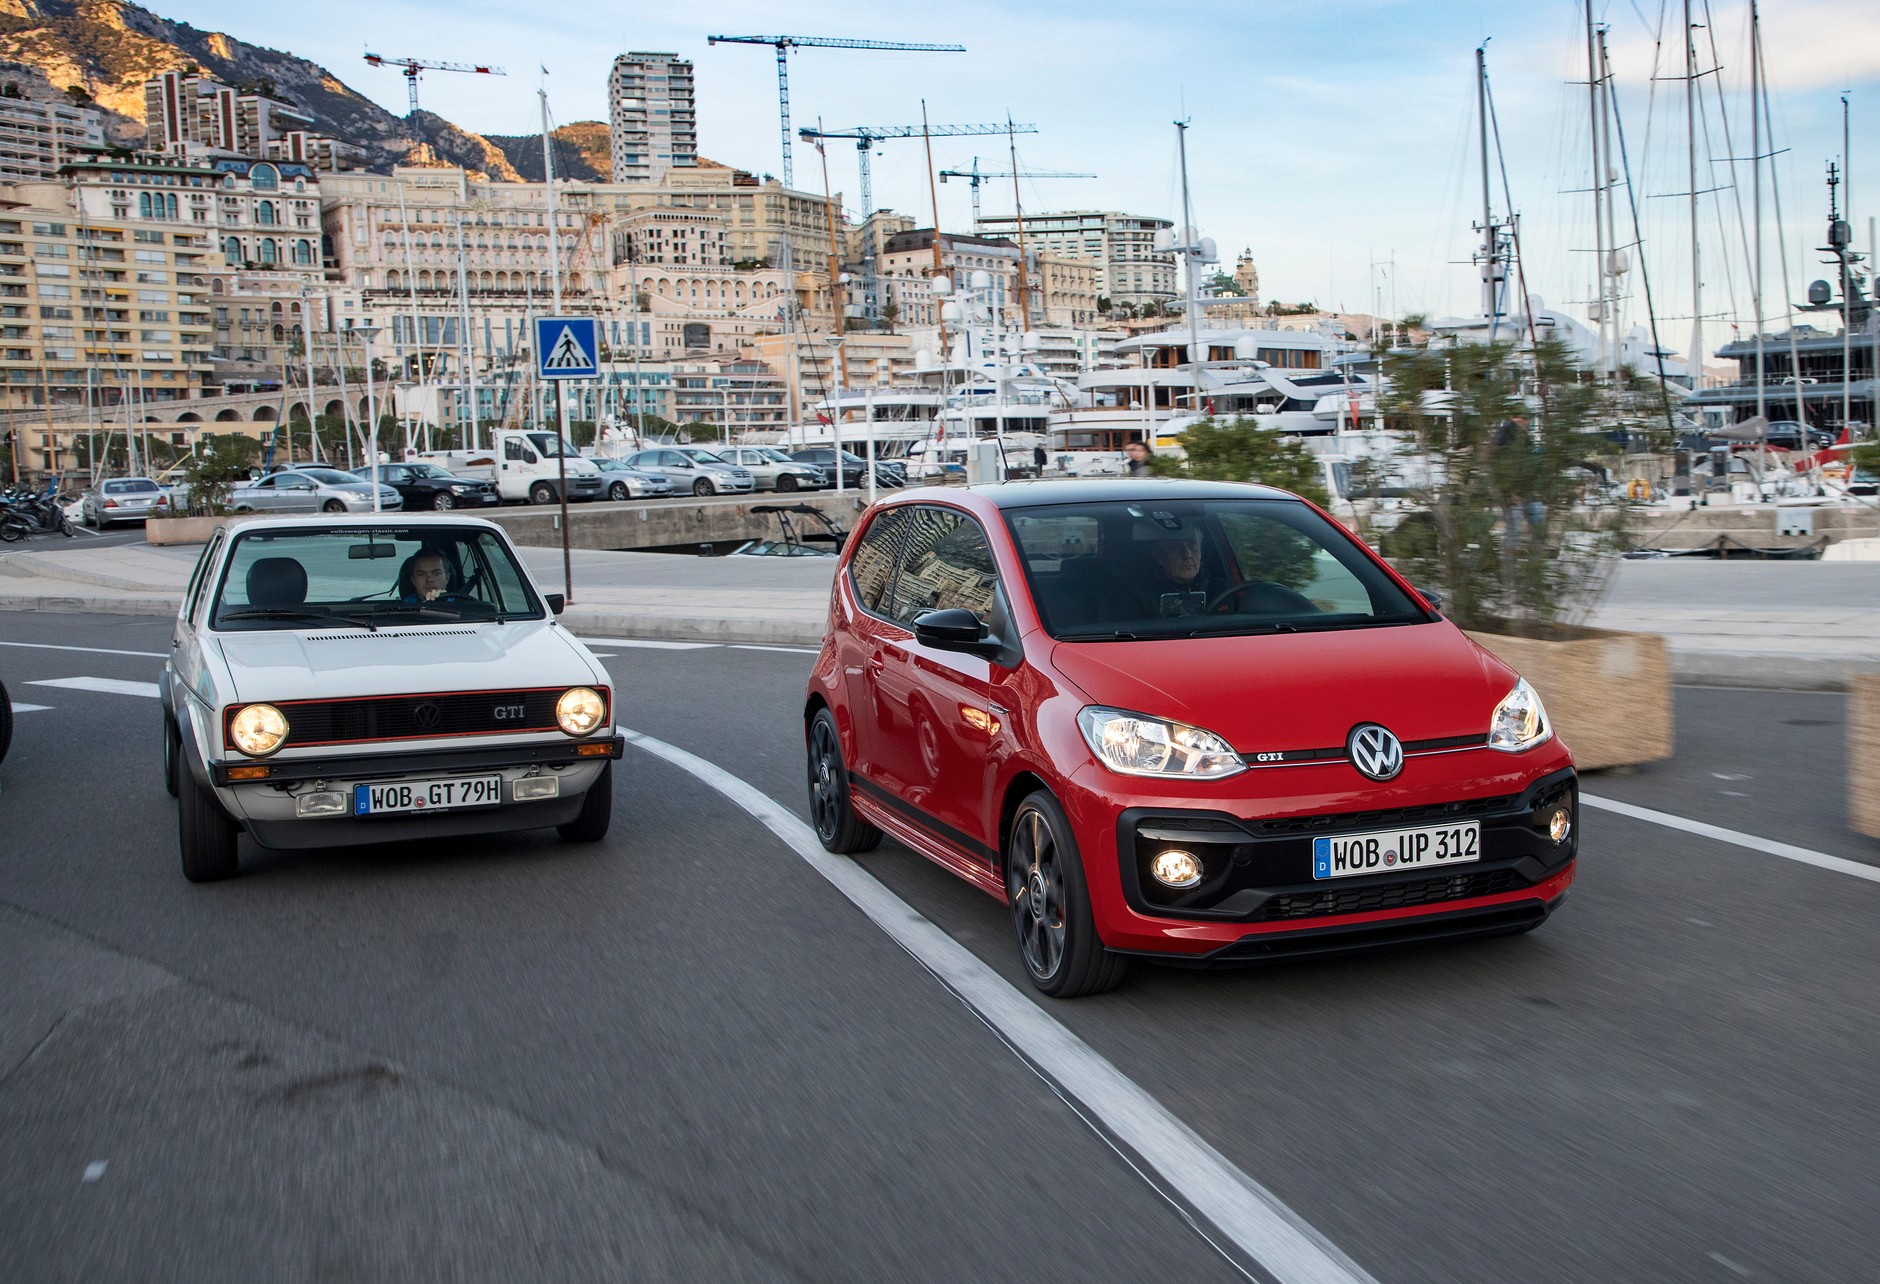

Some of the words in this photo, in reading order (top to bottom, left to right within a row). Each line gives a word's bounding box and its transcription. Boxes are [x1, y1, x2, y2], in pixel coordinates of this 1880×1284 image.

[494, 705, 525, 719] GTI
[1256, 752, 1284, 762] GTI
[1352, 725, 1404, 777] VW
[371, 786, 412, 810] WOB
[429, 783, 455, 805] GT
[460, 780, 499, 803] 79H
[1333, 838, 1380, 871] WOB
[1399, 833, 1429, 863] UP
[1435, 827, 1477, 860] 312
[1319, 862, 1327, 871] D
